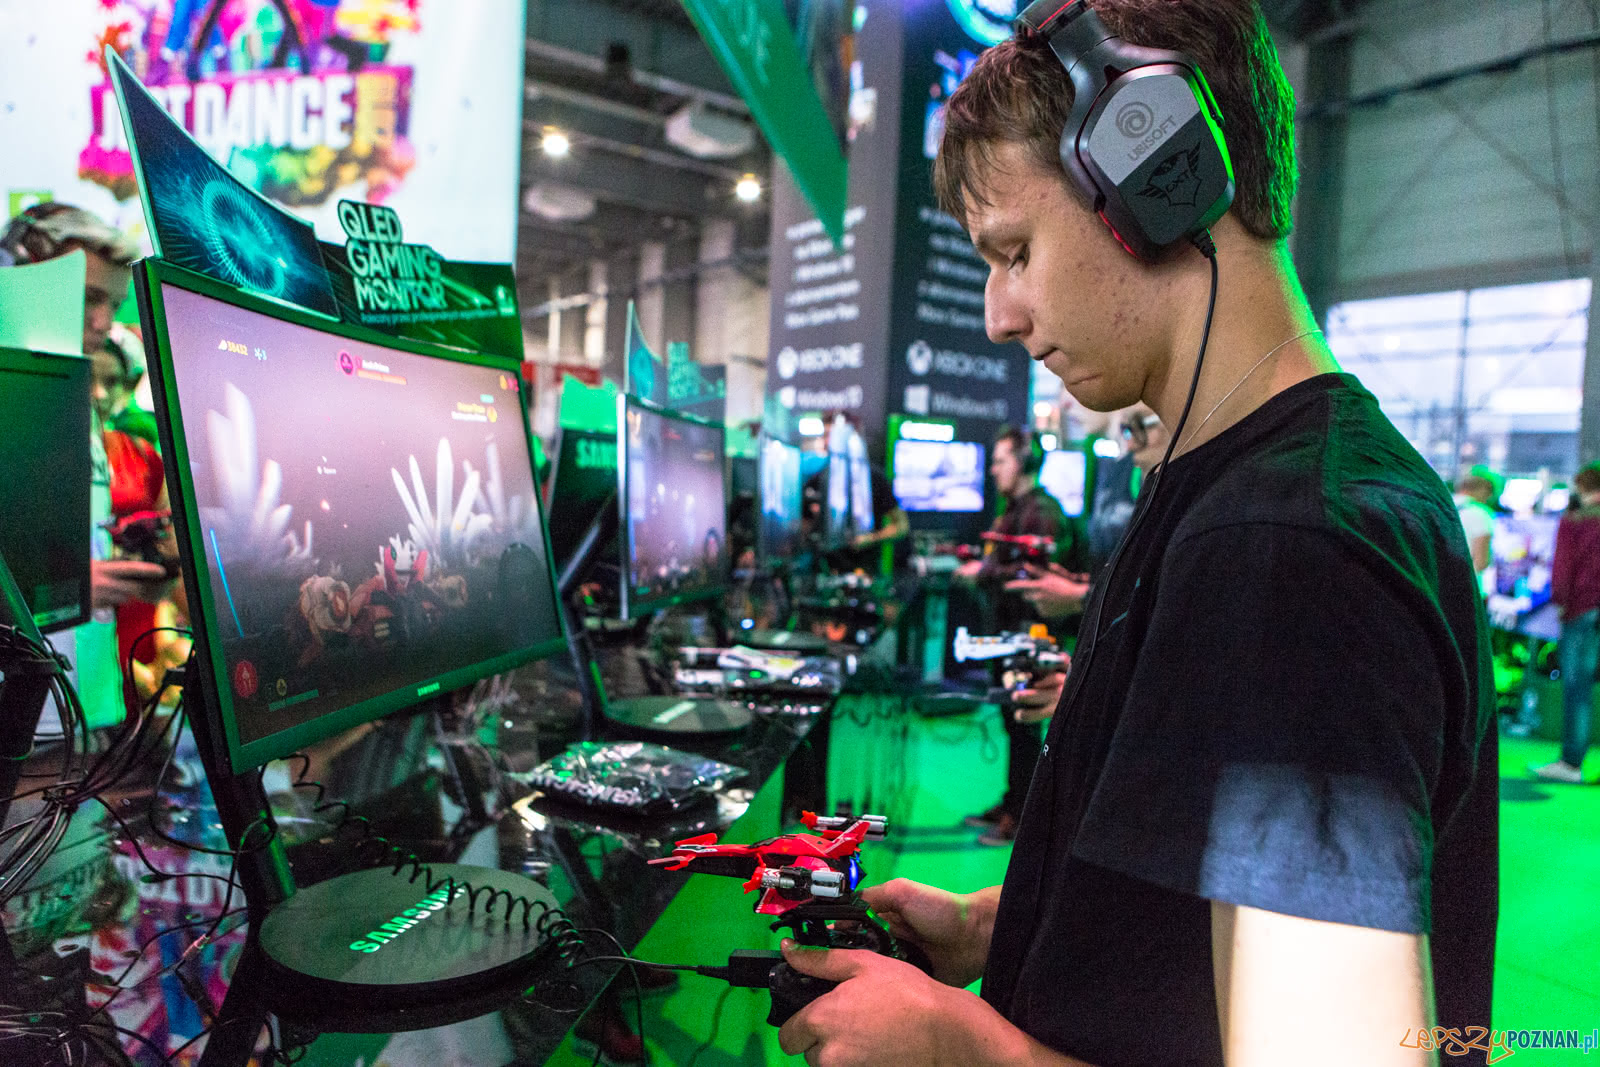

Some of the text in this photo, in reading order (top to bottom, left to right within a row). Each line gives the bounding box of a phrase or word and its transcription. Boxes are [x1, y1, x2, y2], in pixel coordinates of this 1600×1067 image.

[193, 74, 354, 152] DANCE
[1128, 115, 1177, 162] UBISOFT
[339, 200, 400, 242] QLED
[347, 238, 441, 278] GAMING
[353, 276, 448, 311] MONITOR
